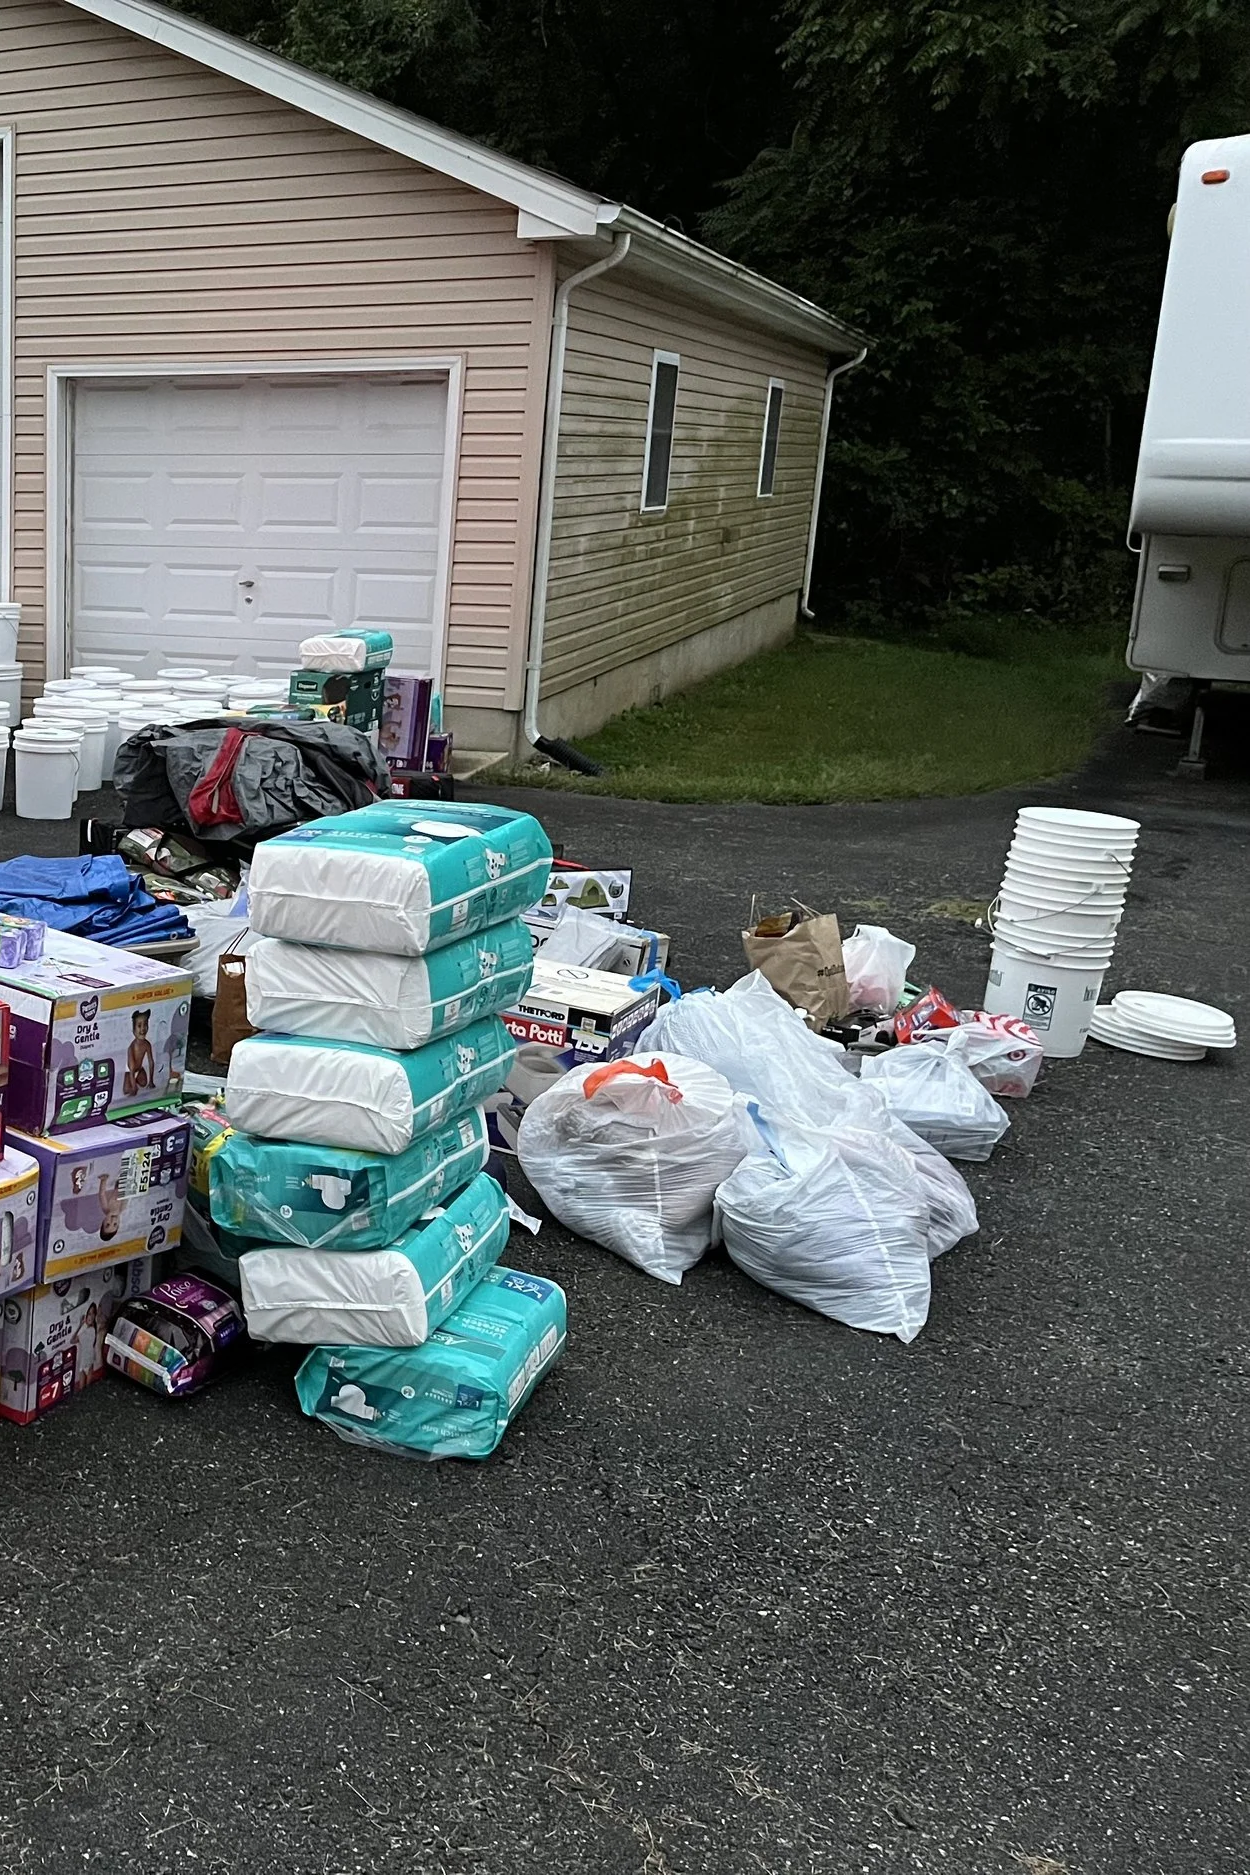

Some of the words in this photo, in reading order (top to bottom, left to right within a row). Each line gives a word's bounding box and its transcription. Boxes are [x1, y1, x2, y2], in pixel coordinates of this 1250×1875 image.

[518, 1004, 565, 1021] THETFORD
[74, 1031, 100, 1044] Gentle
[76, 1023, 93, 1036] Dry
[92, 1022, 98, 1031] &
[506, 1021, 526, 1037] rta
[529, 1023, 563, 1046] Potti
[96, 1092, 106, 1101] 162
[73, 1099, 88, 1119] 5
[166, 1135, 175, 1153] 3
[138, 1151, 151, 1193] F5124
[504, 1278, 543, 1300] L/XL
[46, 1325, 73, 1346] Gentle
[49, 1321, 66, 1336] Dry
[51, 1381, 60, 1399] 7
